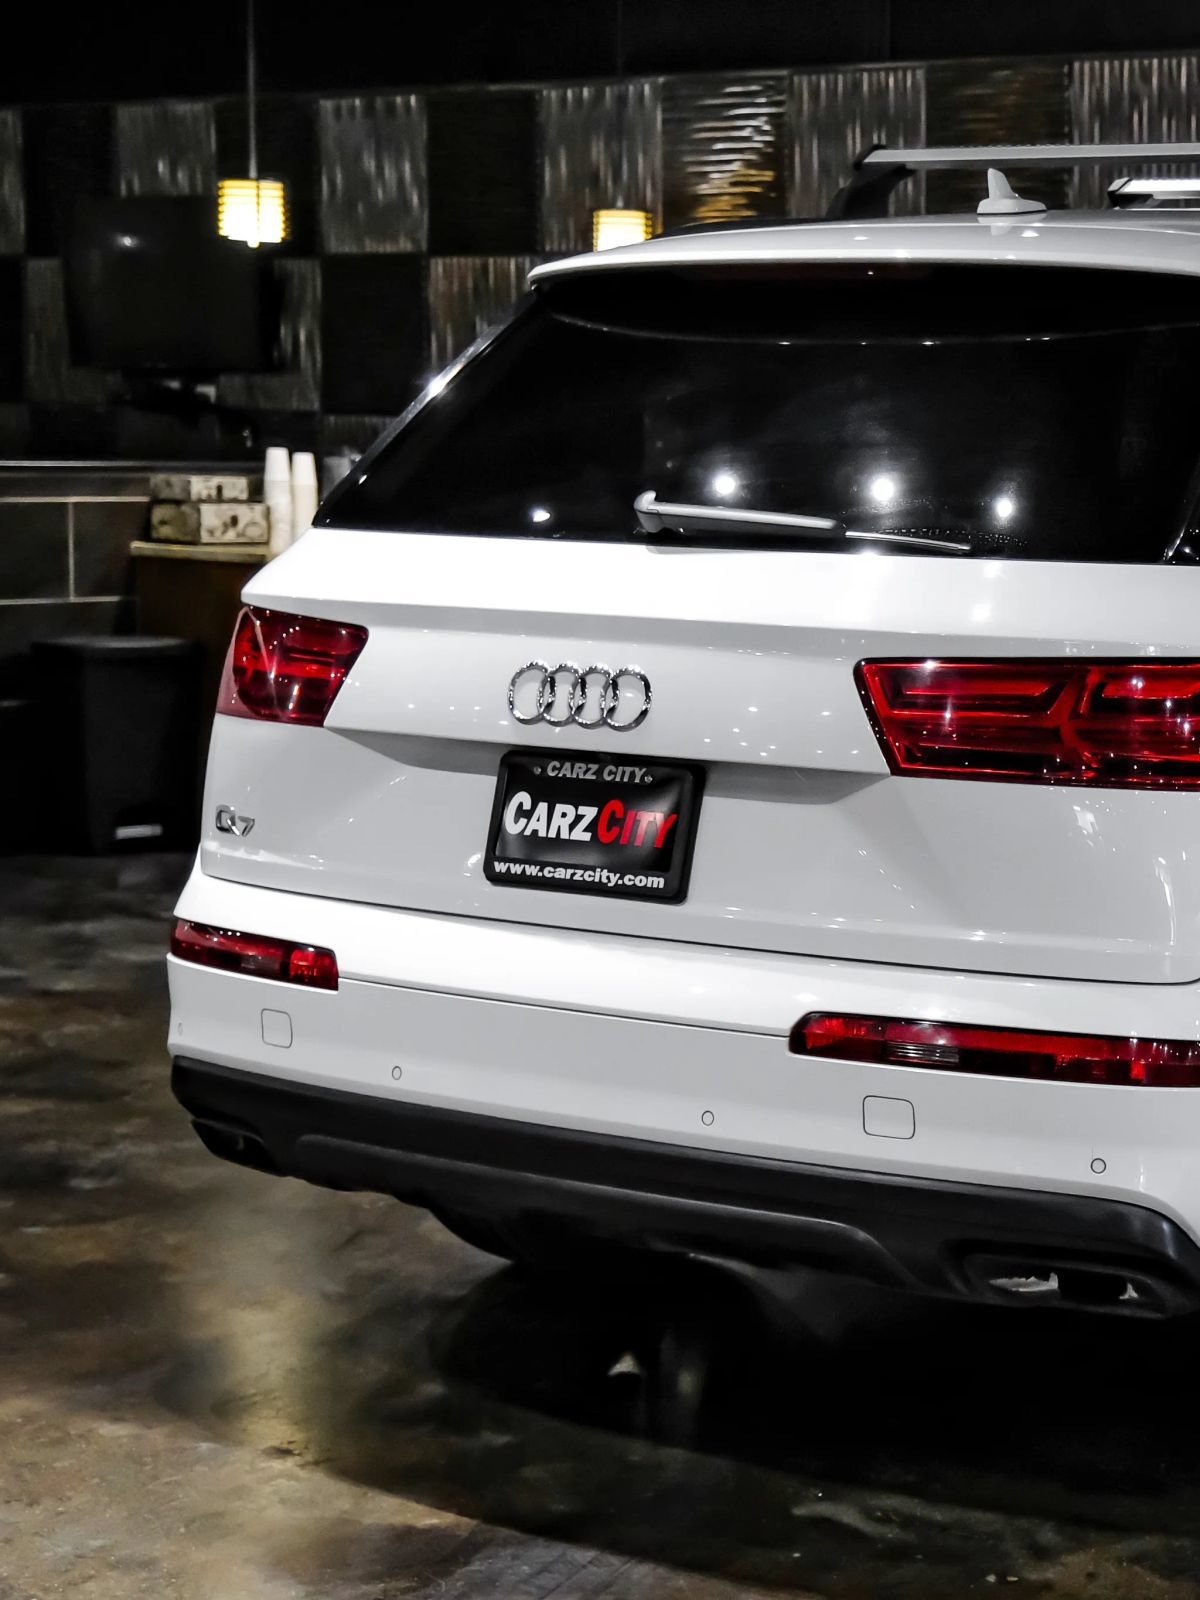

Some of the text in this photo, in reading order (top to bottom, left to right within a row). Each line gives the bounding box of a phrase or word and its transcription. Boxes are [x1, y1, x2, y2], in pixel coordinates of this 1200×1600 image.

[546, 761, 647, 783] CARZ CITY
[215, 804, 256, 837] Q7
[493, 861, 665, 888] www.carzcity.com
